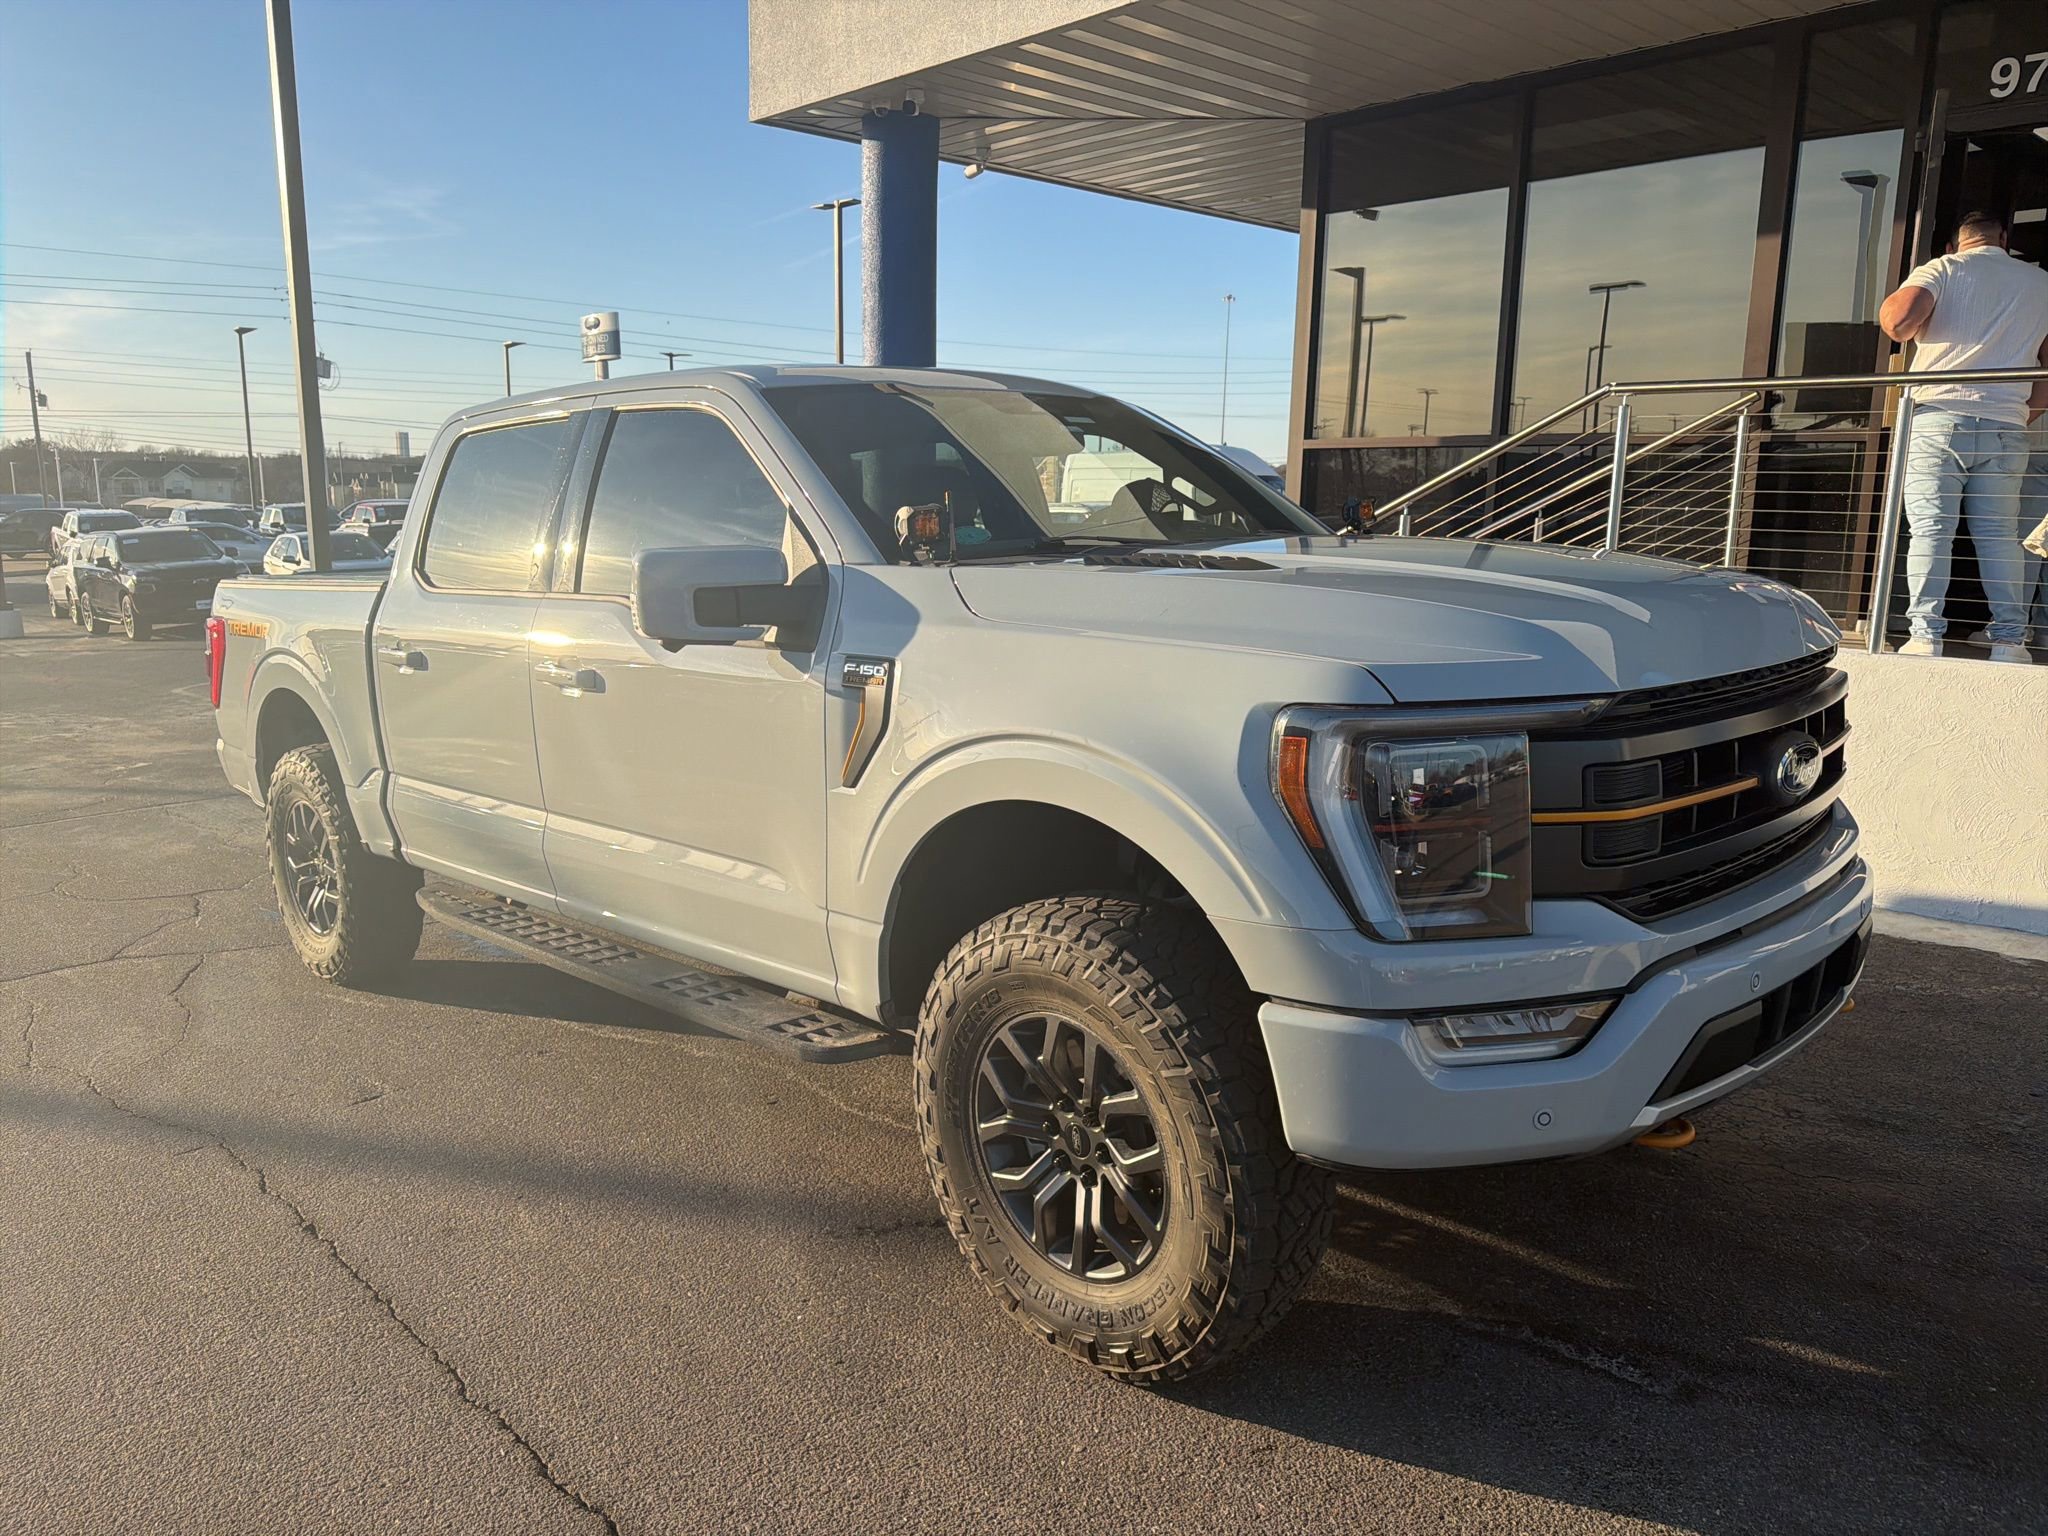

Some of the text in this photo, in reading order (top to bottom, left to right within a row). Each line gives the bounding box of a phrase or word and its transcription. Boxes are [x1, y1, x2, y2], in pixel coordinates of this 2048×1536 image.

[1990, 52, 2048, 98] 97
[228, 620, 270, 638] TREMOR
[843, 663, 885, 676] F-150
[964, 1197, 1176, 1329] RECON GRAPPLER A/T
